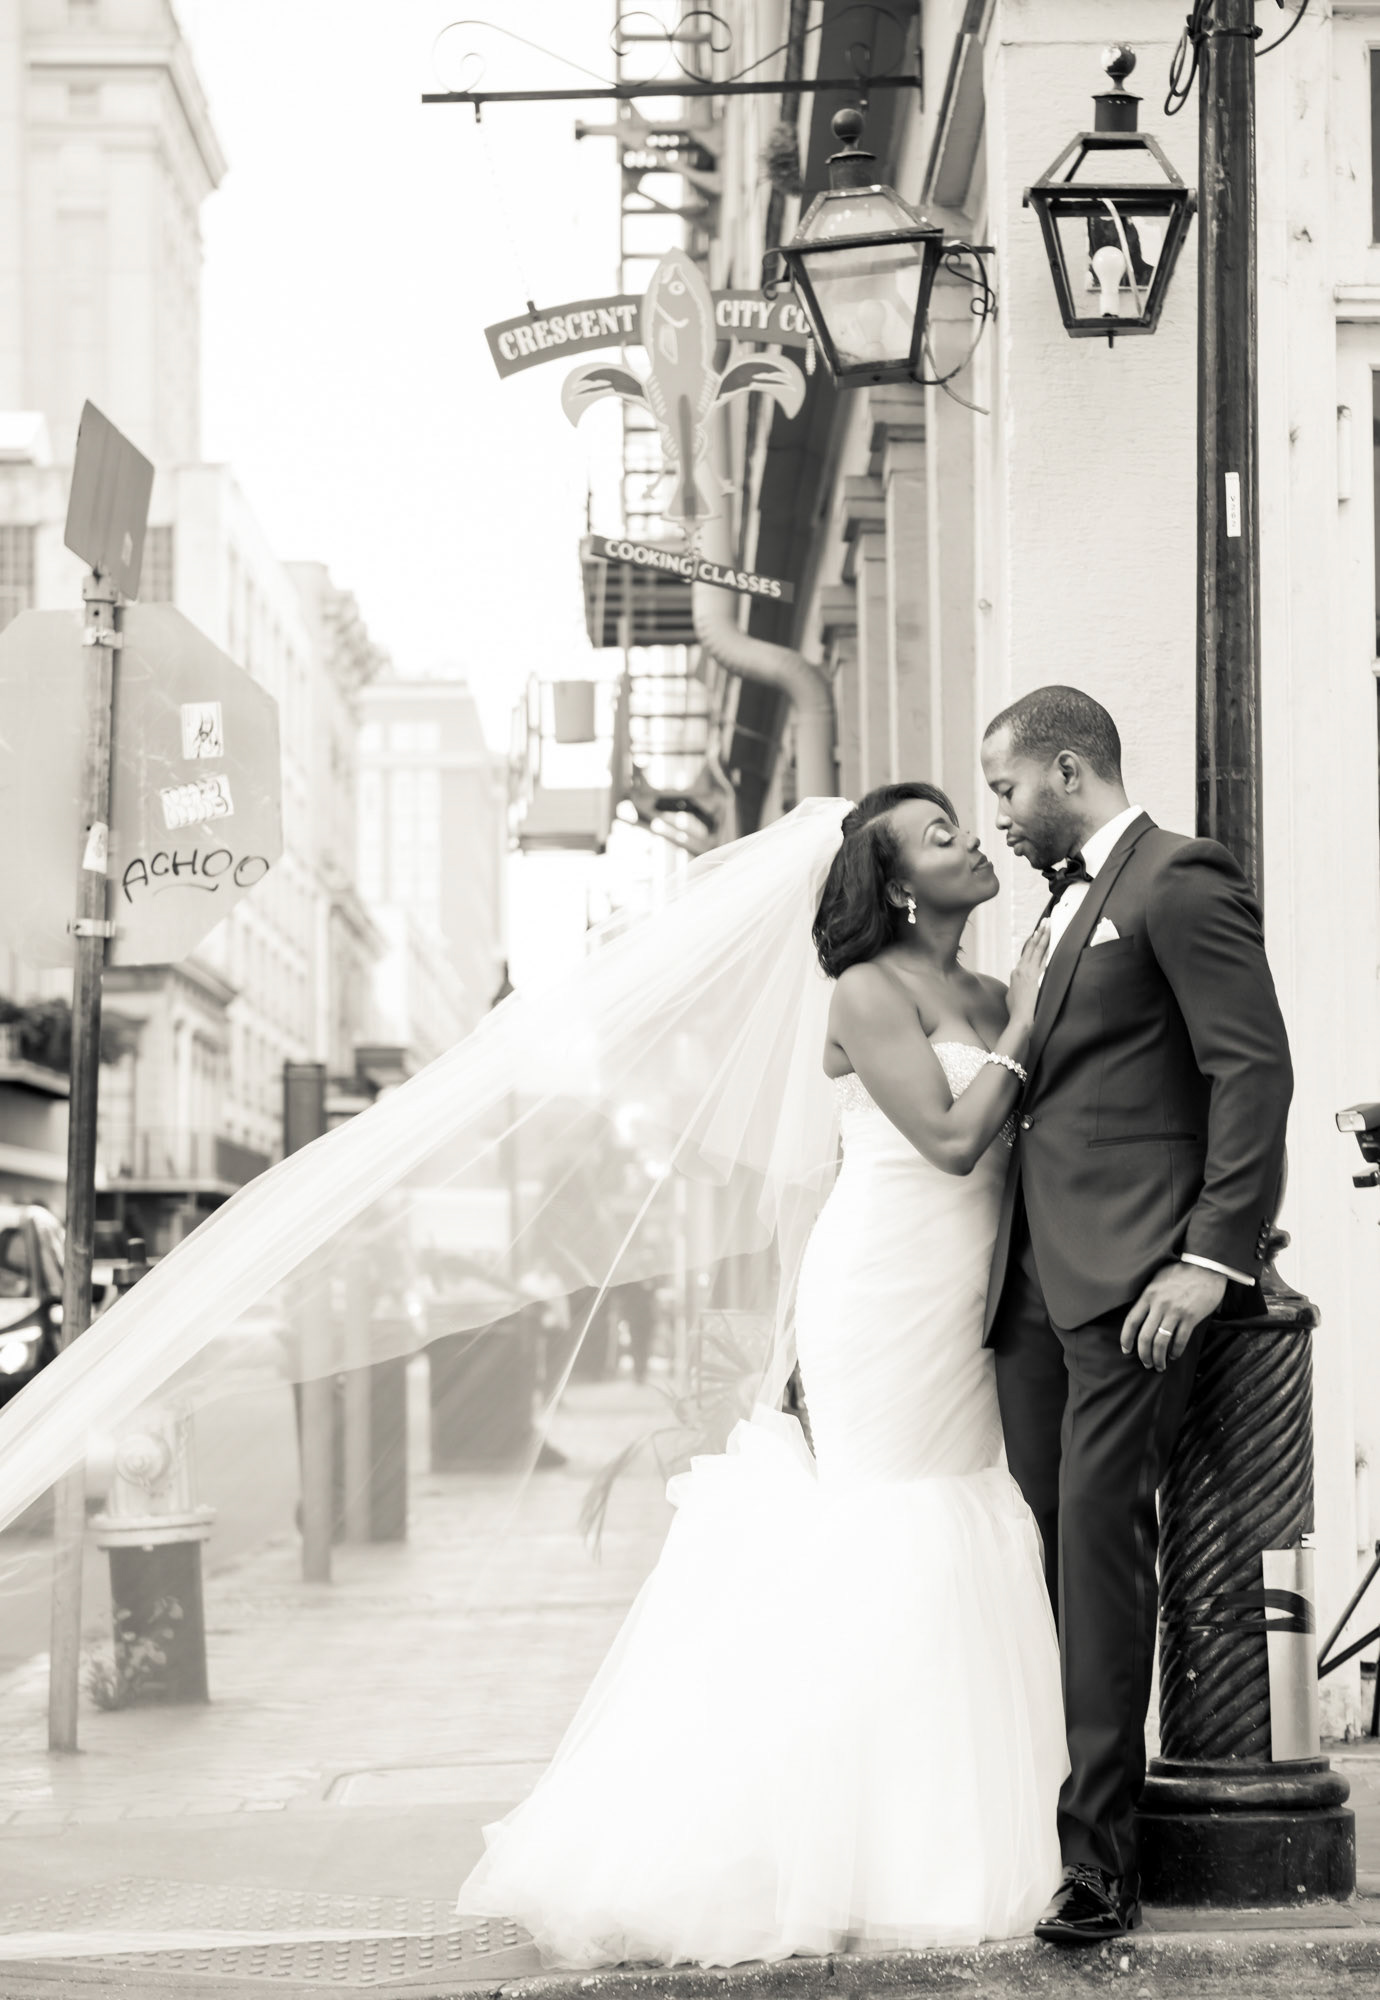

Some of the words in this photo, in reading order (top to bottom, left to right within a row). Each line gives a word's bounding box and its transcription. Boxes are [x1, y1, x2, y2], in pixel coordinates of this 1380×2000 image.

[498, 303, 638, 361] CRESCENT
[715, 299, 777, 329] CITY
[603, 539, 693, 576] COOKING
[698, 563, 782, 598] CLASSES
[122, 848, 271, 904] ACHOO
